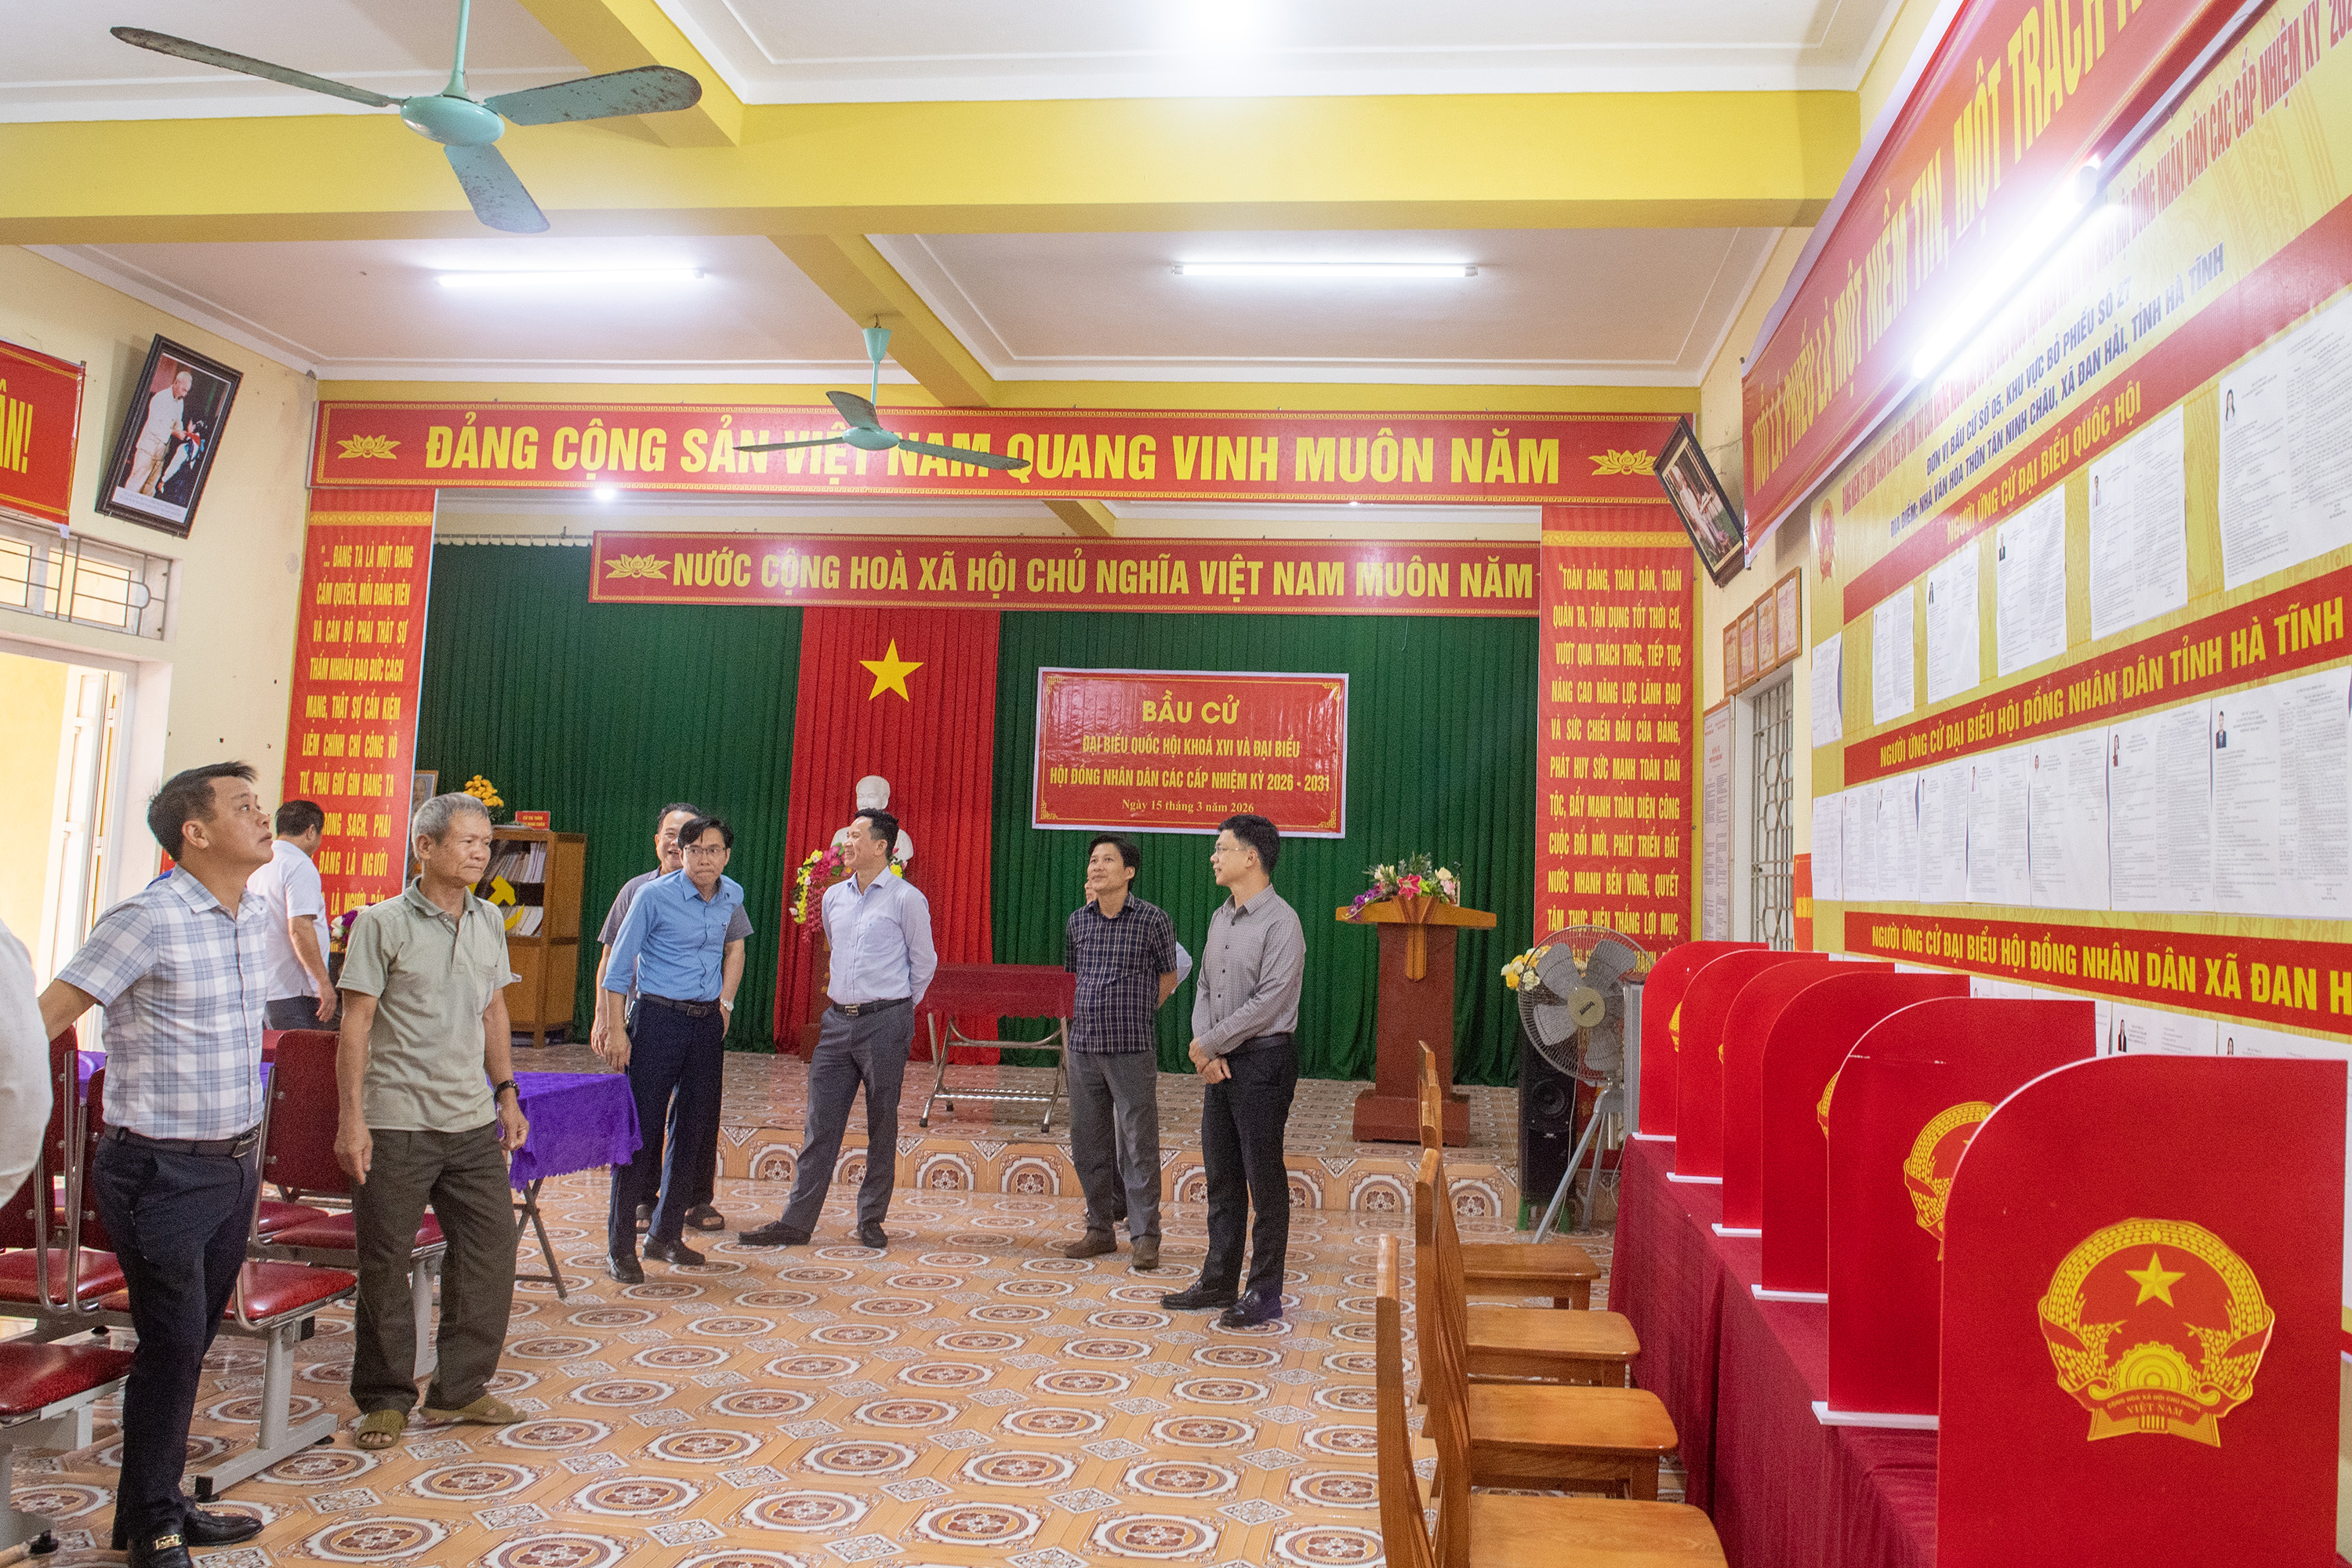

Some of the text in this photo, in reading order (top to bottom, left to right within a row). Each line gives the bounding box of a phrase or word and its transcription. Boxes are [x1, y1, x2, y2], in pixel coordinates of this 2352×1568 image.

[2157, 134, 2184, 214] NHÂN
[2186, 110, 2208, 187] DÂN
[2210, 82, 2231, 162] CÁC
[2234, 45, 2256, 140] CẤP
[2259, 16, 2301, 116] NHIỆM
[1954, 56, 2001, 240] MỘT
[1919, 485, 1933, 514] NHÀ
[1933, 474, 1947, 503] VĂN
[1965, 448, 1985, 478] THÔN
[1987, 430, 2003, 461] TÂN
[2005, 408, 2027, 445] NINH
[2030, 387, 2058, 426] CHÂU,
[2060, 365, 2074, 401] XÃ
[2078, 347, 2101, 387] ĐAN
[2104, 323, 2128, 366] HẢI,
[2131, 295, 2161, 343] TỈNH
[2165, 273, 2185, 315] HÀ
[2188, 241, 2224, 296] TĨNH
[1927, 448, 1940, 477] ĐƠN
[1942, 441, 1948, 464] VỊ
[1950, 424, 1965, 456] BẦU
[1966, 410, 1978, 441] CỬ
[1979, 396, 1989, 431] SỐ
[1991, 394, 2004, 419] 05,
[2005, 373, 2024, 407] KHU
[2026, 353, 2044, 389] VỰC
[2046, 332, 2060, 372] BỎ
[2063, 306, 2094, 358] PHIẾU
[2098, 285, 2113, 326] SỐ
[2117, 275, 2132, 310] 27
[426, 411, 1559, 485] ĐẢNG CỘNG SẢN VIỆT NAM QUANG VINH MUÔN NĂM
[1947, 380, 2140, 545] NGƯỜI ỨNG CỬ ĐẠI BIỂU QUỐC HỘI
[333, 535, 413, 572] ĐẢNG TA LÀ MỘT ĐẢNG
[672, 545, 1534, 603] NƯỚC CỘNG HOÀ XÃ HỘI CHỦ NGHĨA VIỆT NAM MUÔN NĂM
[1587, 561, 1610, 593] ĐẢNG,
[1615, 565, 1634, 590] TOÀN
[1639, 565, 1657, 593] DÂN,
[1662, 565, 1682, 591] TOÀN
[314, 611, 408, 648] VÀ CÁN BỘ PHẢI THẬT SỰ
[1553, 599, 1681, 633] QUÂN TA, TẬN DỤNG TỐT THỜI CƠ,
[1552, 676, 1681, 710] NÂNG CAO NĂNG LỰC LÃNH ĐẠO
[1881, 596, 2344, 768] NGƯỜI ỨNG CỬ ĐẠI BIỂU HỘI ĐỒNG NHÂN DÂN TỈNH HÀ TĨNH
[1142, 690, 1240, 724] BẦU CỬ
[1083, 731, 1300, 759] ĐẠI BIỂU QUỐC HỘI KHOÁ XVI VÀ ĐẠI BIỂU
[1051, 764, 1068, 787] HỘI
[1070, 761, 1099, 785] ĐỒNG
[1104, 765, 1133, 786] NHÂN
[1137, 767, 1159, 787] DÂN
[1162, 766, 1183, 787] CÁC
[1187, 766, 1208, 789] CẤP
[1211, 768, 1247, 793] NHIỆM
[1250, 769, 1265, 789] KỲ
[1267, 775, 1294, 790] 2026
[1305, 775, 1330, 791] 2031
[1123, 799, 1254, 814] Ngày 15 tháng 3 năm 2026
[1872, 922, 1899, 949] NGƯỜI
[1902, 924, 1922, 953] ỨNG
[1926, 924, 1942, 956] CỬ
[1944, 933, 1963, 964] ĐẠI
[1967, 925, 1997, 964] BIỂU
[2001, 933, 2026, 973] HỘI
[2031, 932, 2077, 975] ĐỒNG
[2083, 942, 2140, 985] NHÂN
[2147, 946, 2196, 993] DÂN
[2205, 952, 2241, 1000] XÃ
[2251, 963, 2317, 1011] ĐAN
